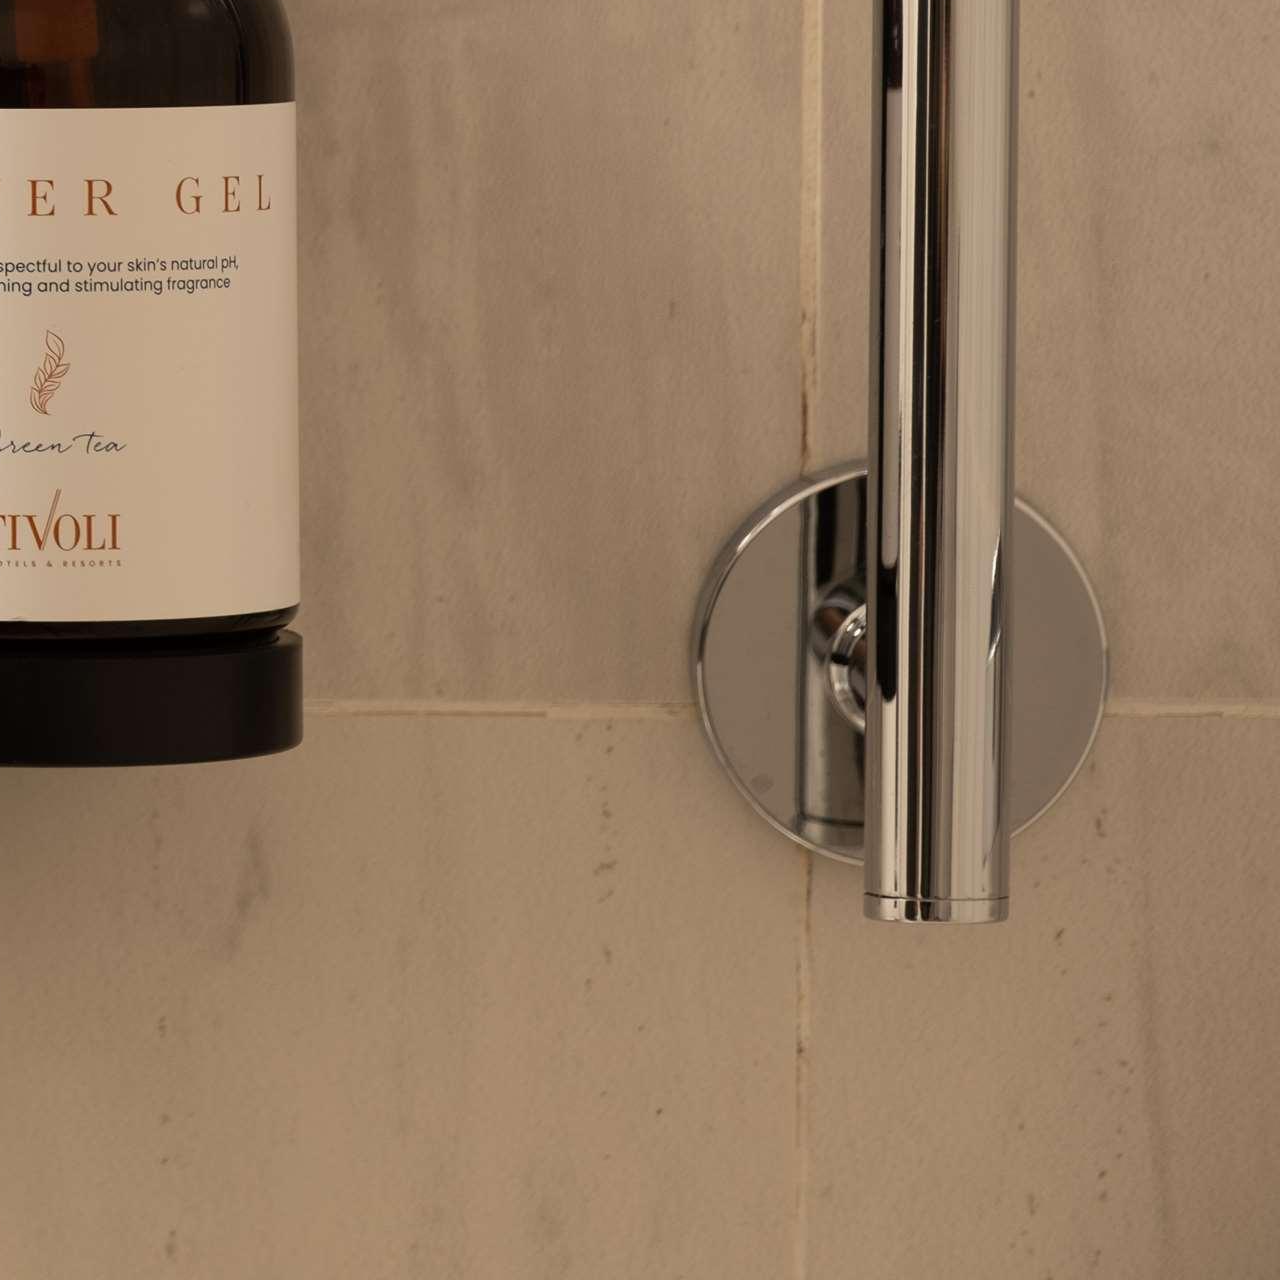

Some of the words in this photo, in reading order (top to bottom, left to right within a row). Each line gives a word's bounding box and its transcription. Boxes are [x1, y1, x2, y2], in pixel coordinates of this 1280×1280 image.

[175, 174, 271, 215] GEL
[66, 259, 84, 273] to
[86, 261, 124, 277] your
[170, 255, 218, 272] natural
[220, 255, 239, 273] pH,
[36, 278, 70, 293] and
[74, 277, 164, 296] stimulating
[166, 276, 231, 295] fragrance
[62, 559, 122, 568] RESORTS
